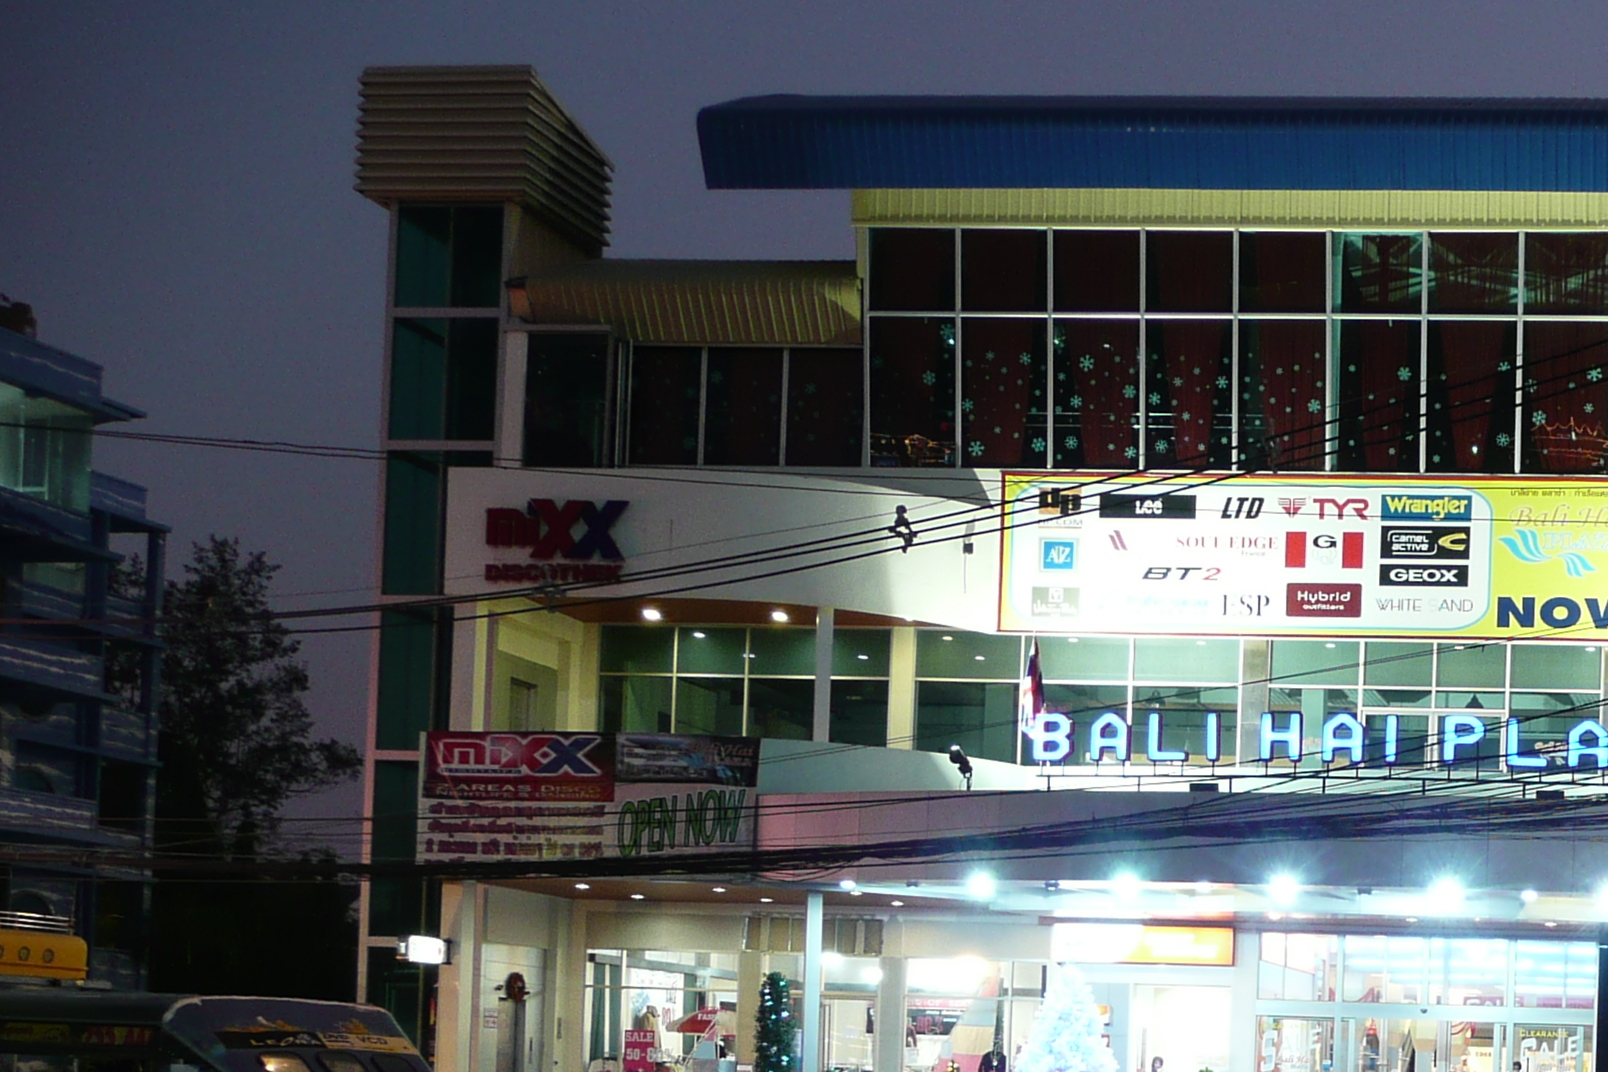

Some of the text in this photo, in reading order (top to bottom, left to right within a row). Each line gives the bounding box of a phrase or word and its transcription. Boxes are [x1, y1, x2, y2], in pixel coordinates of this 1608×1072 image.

[1221, 496, 1265, 519] LTD
[1313, 498, 1370, 520] TYR
[1386, 496, 1468, 519] Wrangler
[1509, 504, 1571, 528] Bali
[1389, 568, 1459, 583] GEOX
[1297, 590, 1351, 604] Hybrid
[1375, 598, 1422, 611] WHITE
[1030, 711, 1222, 764] BALI
[1259, 712, 1398, 764] HAI
[456, 783, 531, 792] AREAS
[618, 789, 746, 856] OPEN NOW
[356, 1035, 388, 1045] VCD
[625, 1031, 654, 1042] SALE
